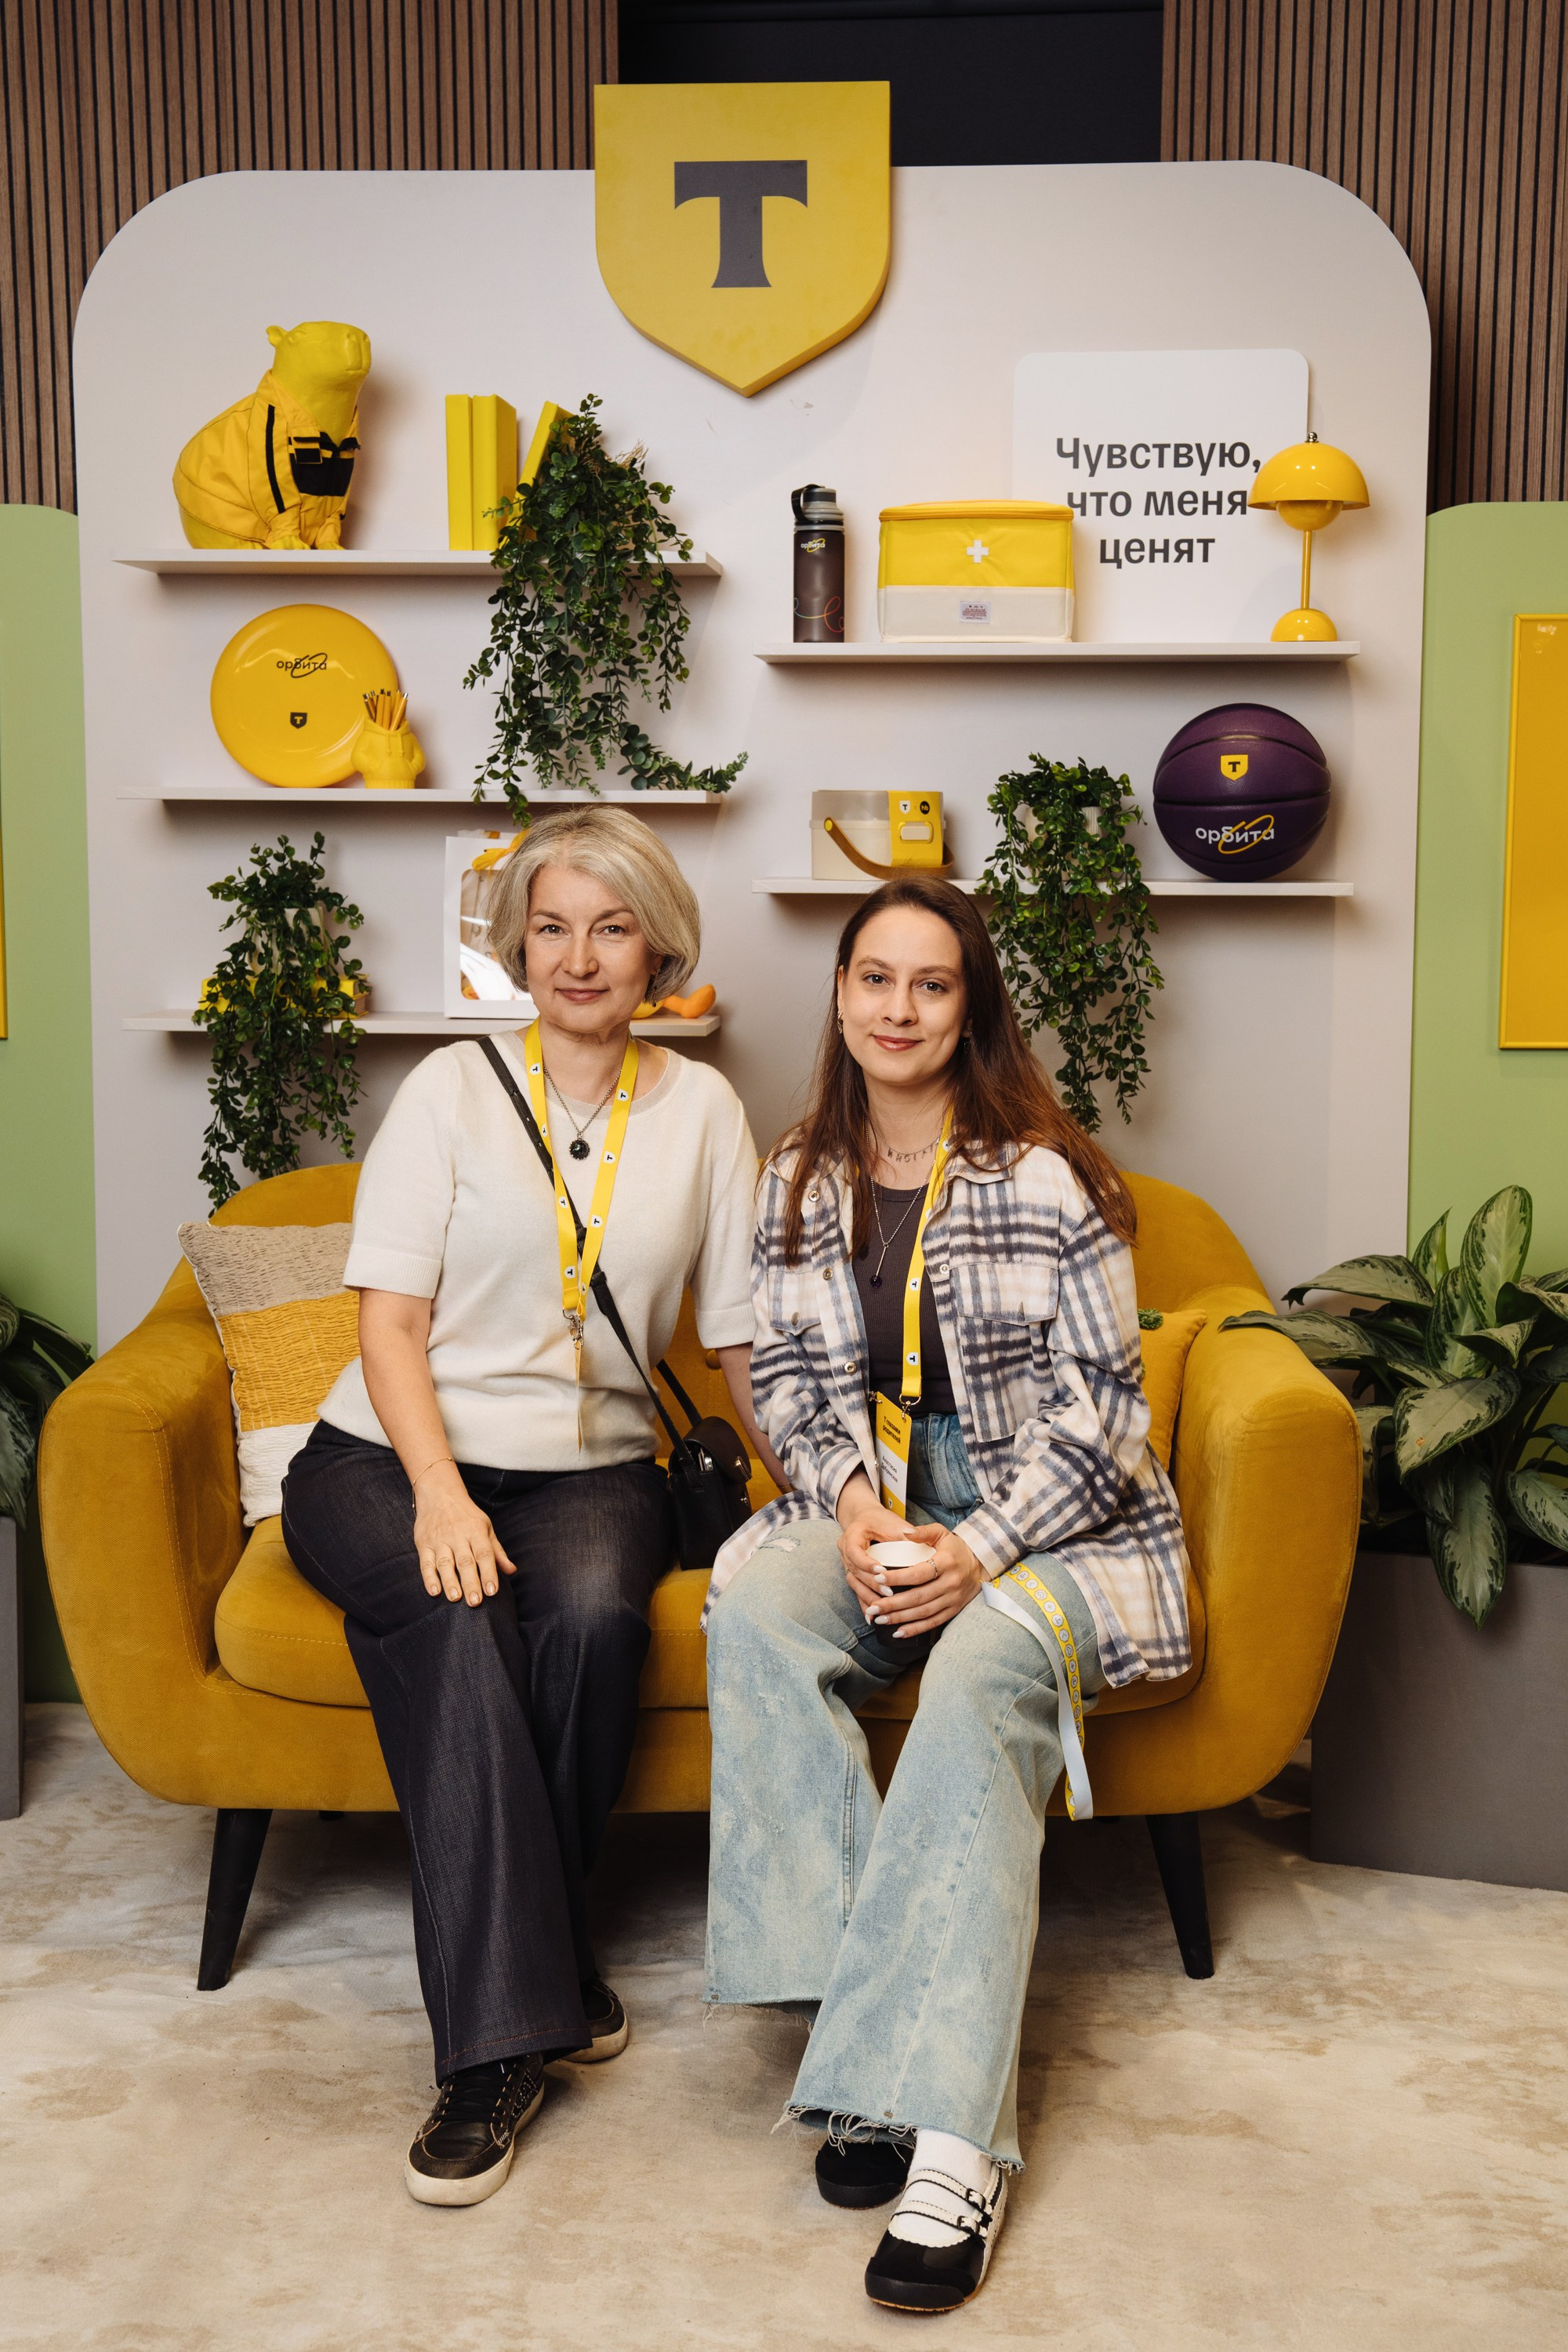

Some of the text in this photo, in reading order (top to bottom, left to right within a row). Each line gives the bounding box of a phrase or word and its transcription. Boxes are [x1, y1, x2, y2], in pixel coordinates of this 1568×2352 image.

[1055, 437, 1261, 477] Чувствую,
[1067, 489, 1248, 517] что меня
[1099, 537, 1216, 570] ценят
[276, 656, 328, 673] орбита
[1196, 824, 1275, 847] орбита
